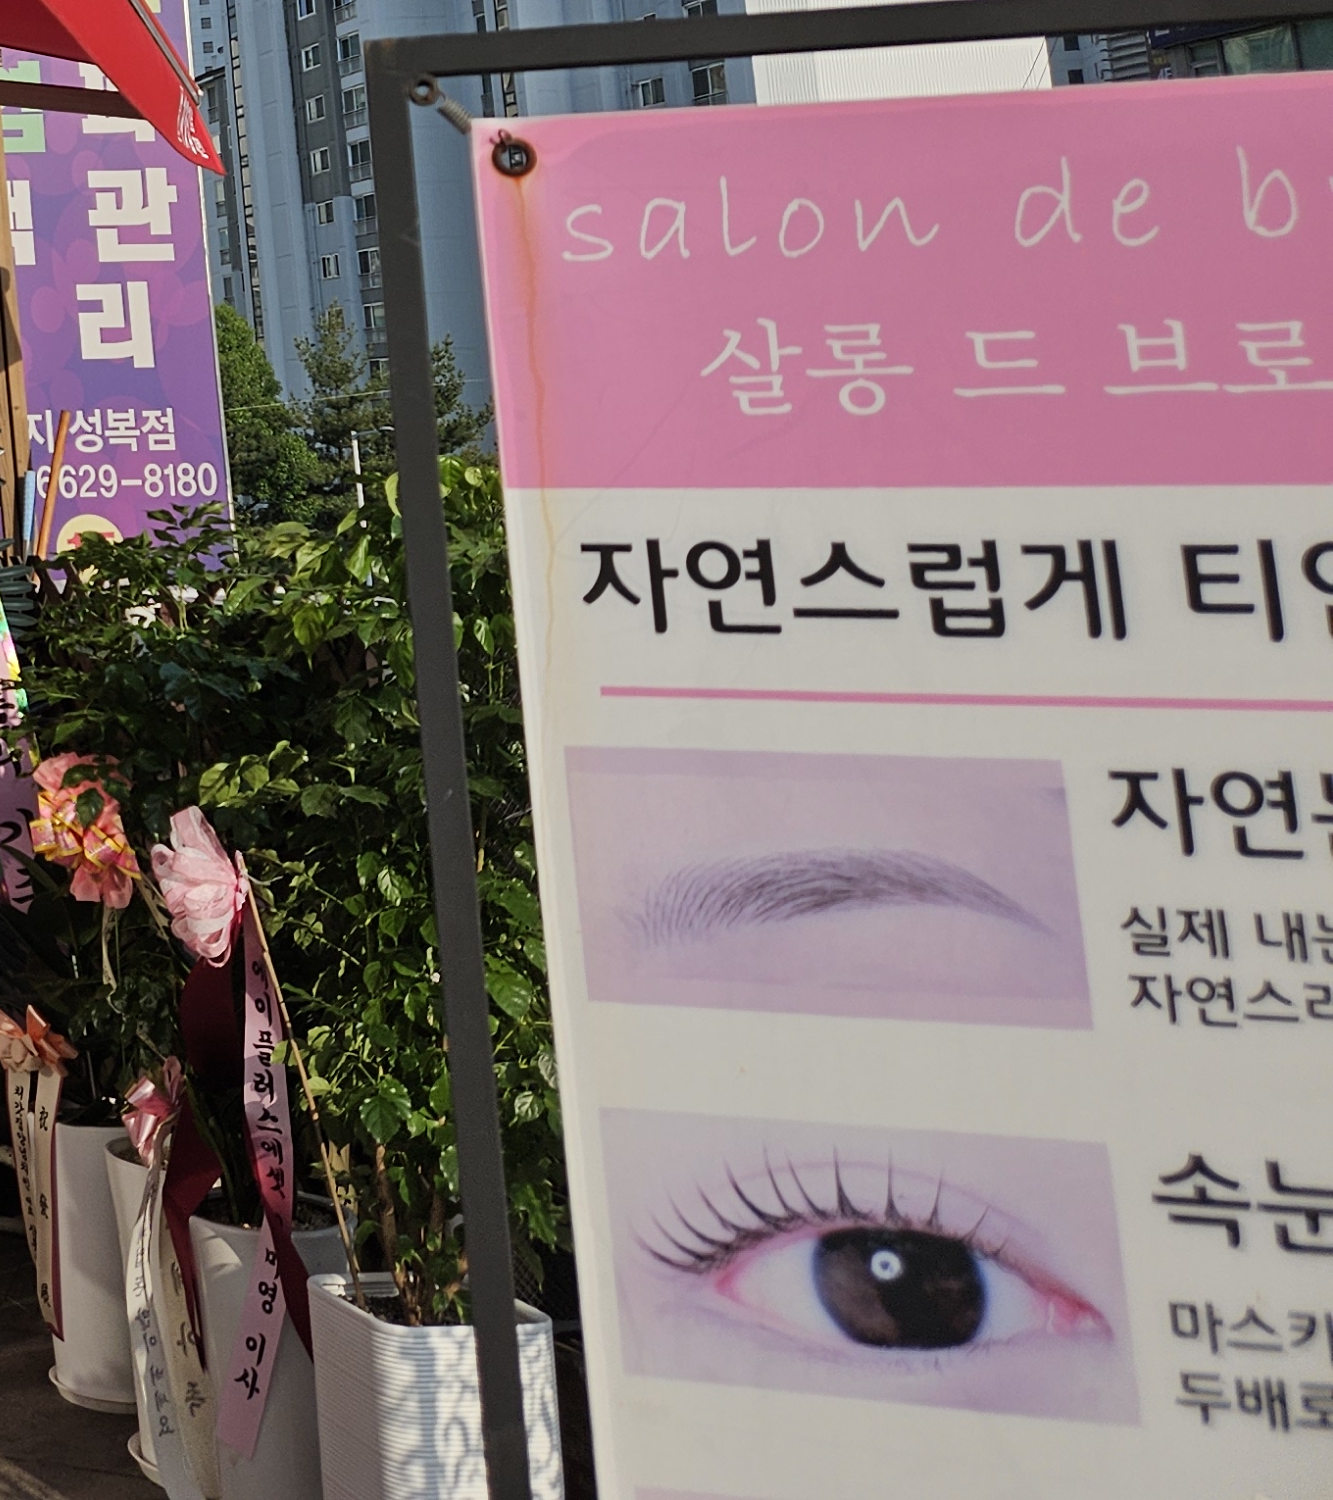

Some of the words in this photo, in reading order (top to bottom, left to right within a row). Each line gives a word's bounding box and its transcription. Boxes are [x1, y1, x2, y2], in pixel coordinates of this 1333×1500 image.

[561, 175, 940, 264] salon
[1014, 155, 1161, 247] de
[1235, 145, 1333, 240] b
[700, 317, 915, 418] 살롱
[953, 330, 1068, 398] 드
[69, 407, 177, 454] 성복점
[580, 537, 1129, 642] 자연스럽게
[1120, 905, 1230, 961] 실제
[233, 1332, 267, 1401] 이사
